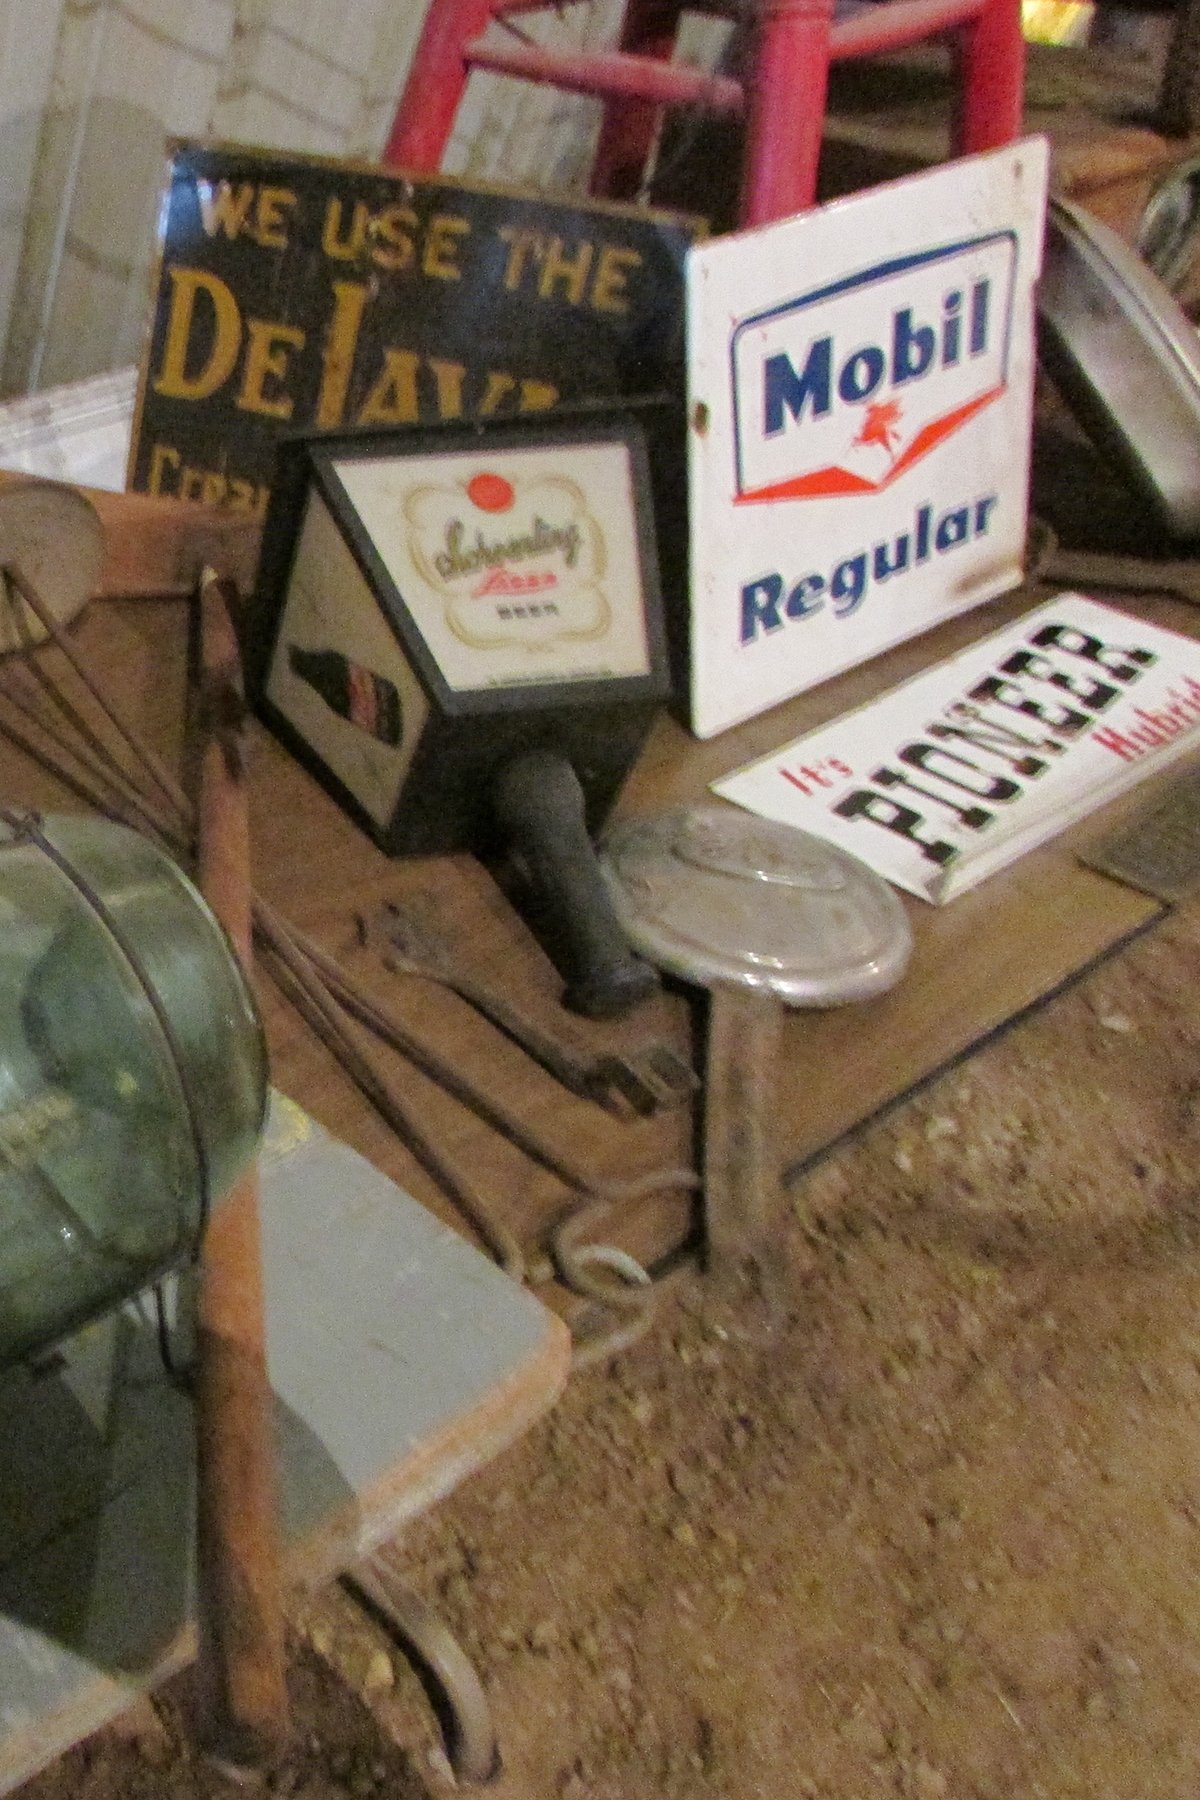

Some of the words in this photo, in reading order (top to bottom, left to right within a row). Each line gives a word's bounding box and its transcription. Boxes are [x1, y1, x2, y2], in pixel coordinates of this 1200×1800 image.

[198, 177, 298, 249] WE
[321, 196, 471, 282] USE
[497, 224, 643, 312] THE
[762, 275, 991, 440] Mobil
[738, 496, 999, 646] Regular
[779, 757, 853, 797] It's
[830, 624, 1159, 865] PIONEER
